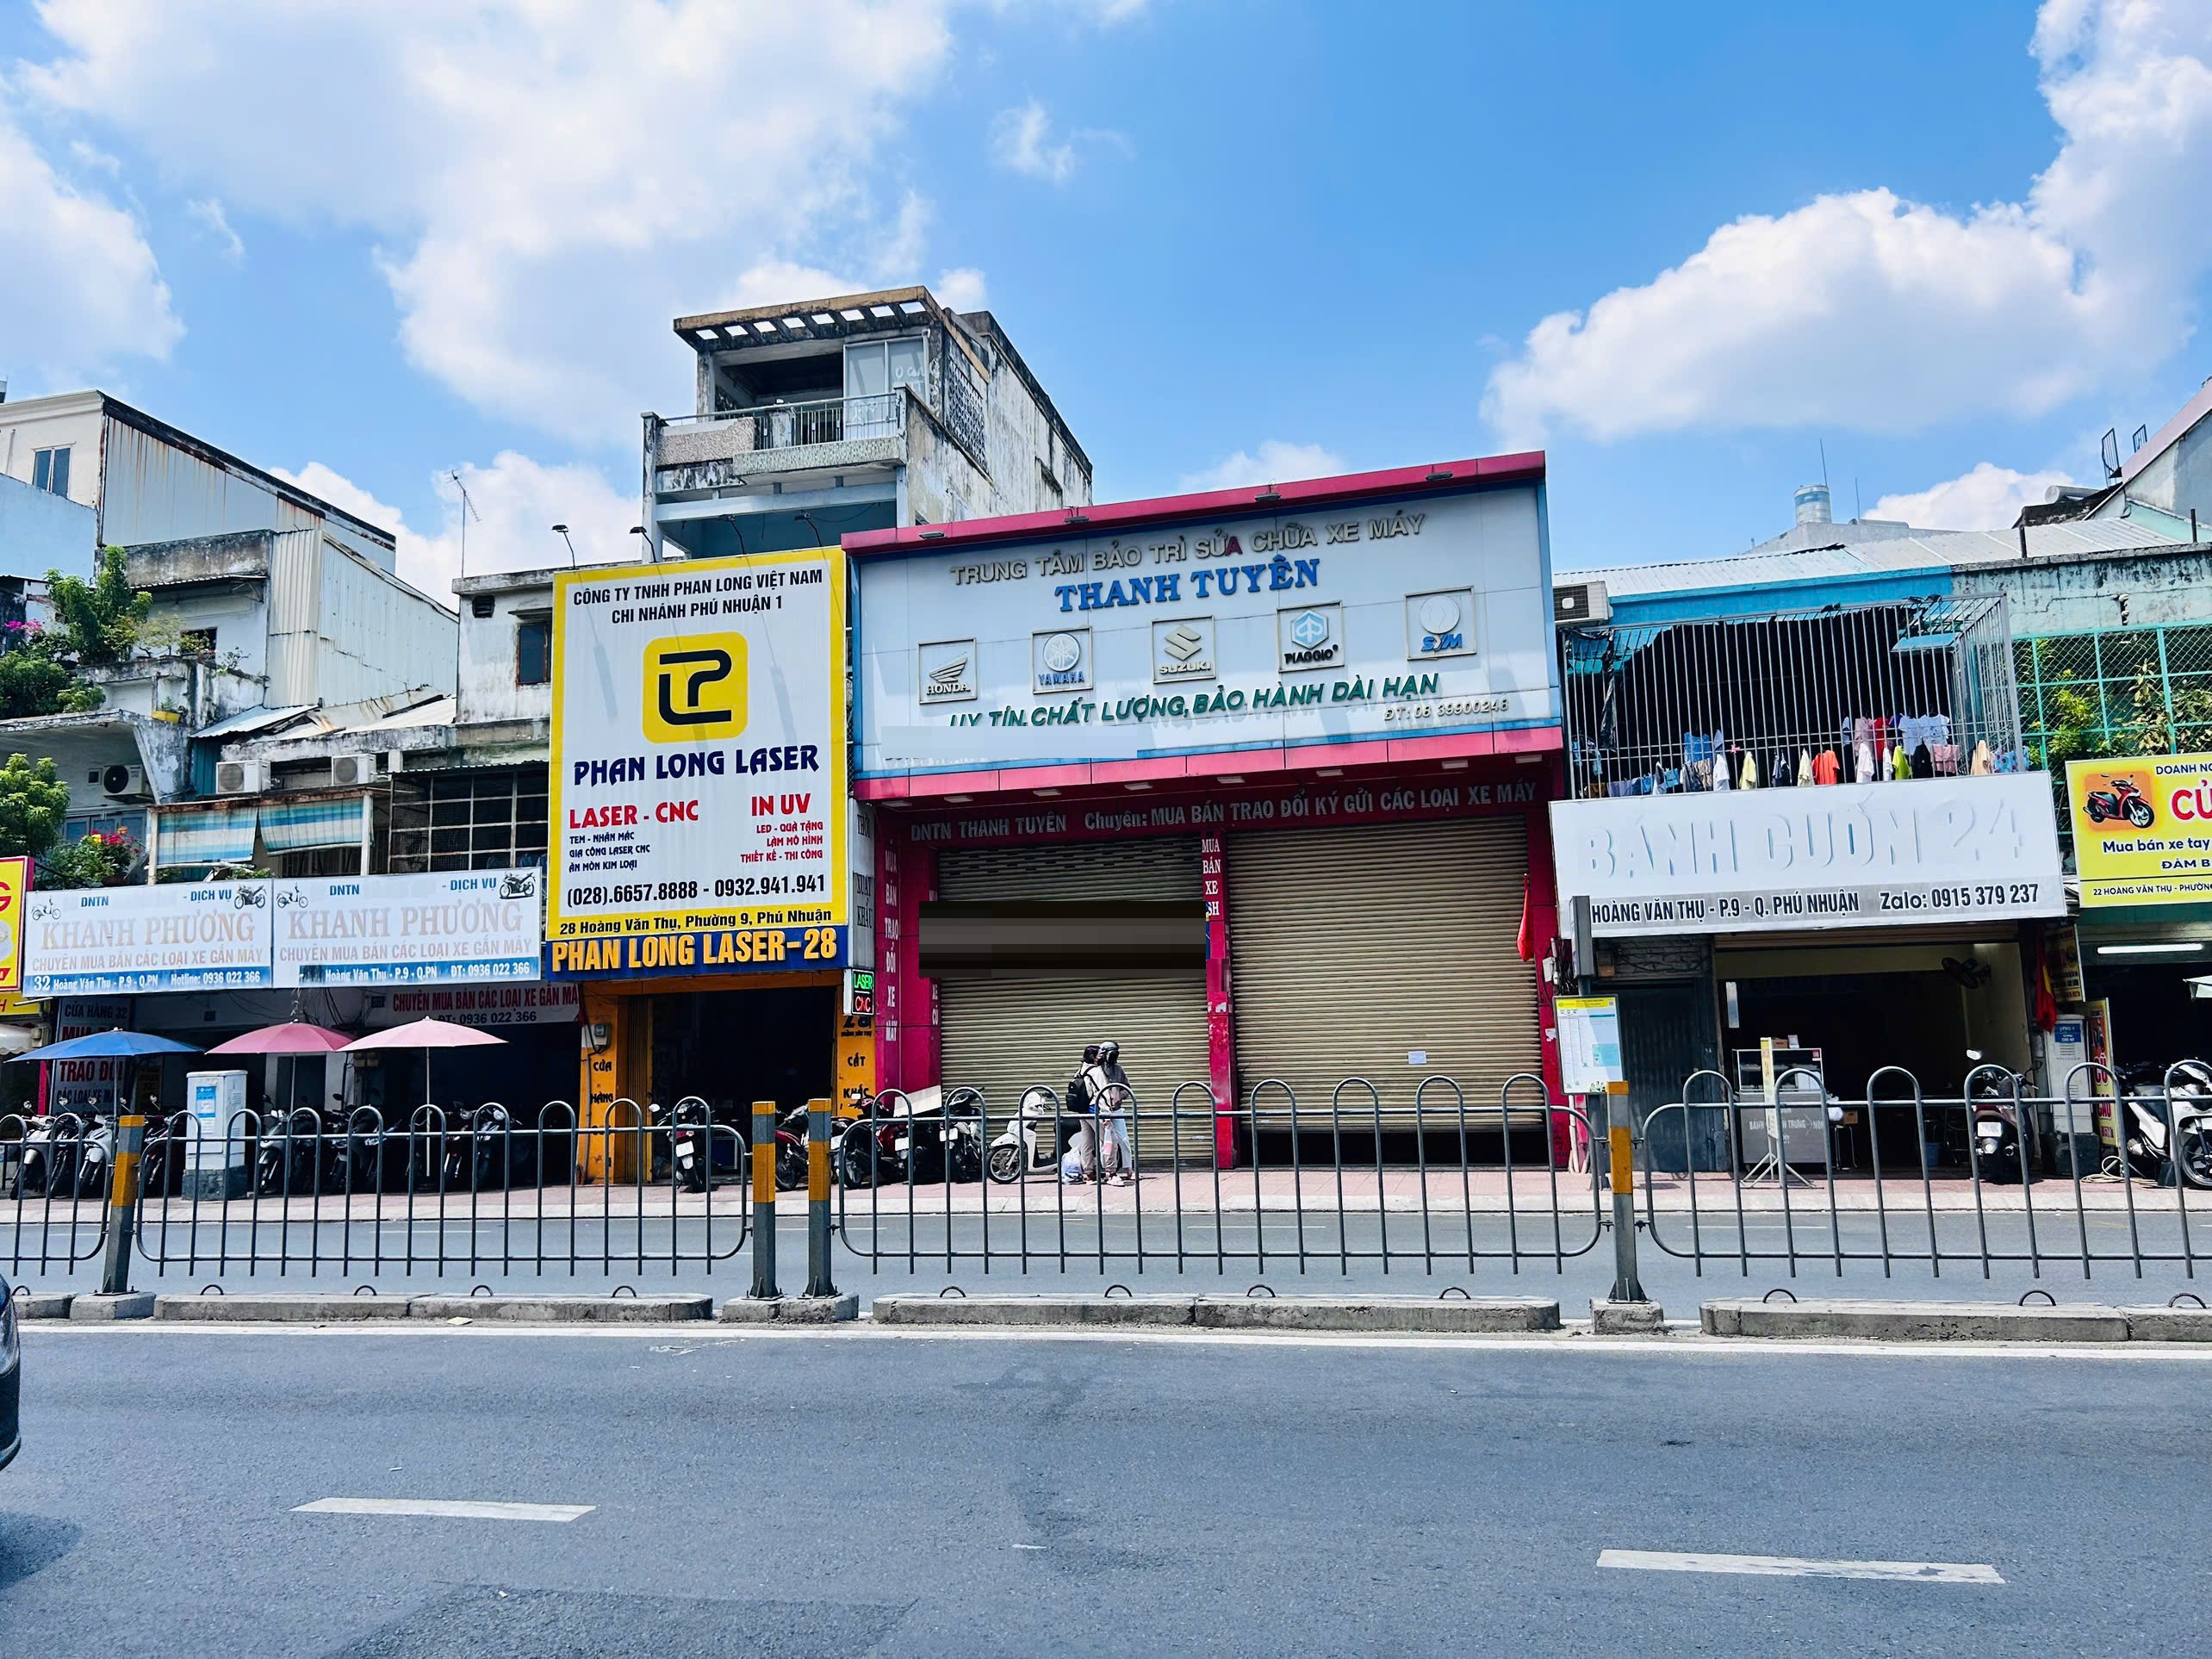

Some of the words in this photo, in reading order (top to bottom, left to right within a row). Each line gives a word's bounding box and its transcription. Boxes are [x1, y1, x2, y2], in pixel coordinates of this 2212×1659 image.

[951, 560, 1027, 585] TRUNG
[1035, 550, 1084, 575] TÂM
[1092, 540, 1141, 570] BẢO
[1150, 539, 1186, 563] TRÌ
[1195, 529, 1242, 559] SỬA
[1249, 523, 1317, 553] CHỮA
[1327, 522, 1359, 544] XE
[1369, 511, 1426, 540] MÁY
[574, 587, 611, 605] CÔNG
[615, 587, 630, 601] TY
[634, 583, 669, 600] TNHH
[674, 581, 711, 596] PHAN
[717, 575, 752, 593] LONG
[756, 570, 786, 588] VIỆT
[790, 569, 823, 586] NAM
[1055, 574, 1180, 612] THANH
[1190, 554, 1320, 598] TUYÊN
[612, 609, 634, 624] CHI
[638, 602, 687, 621] NHÁNH
[691, 598, 718, 617] PHÚ
[723, 596, 771, 614] NHUẬN
[775, 595, 782, 610] 1
[1421, 633, 1462, 652] SYM
[1284, 649, 1333, 664] PIAGGIO
[1159, 661, 1212, 674] SUZUKI
[1038, 671, 1084, 686] YAMAHA
[926, 682, 971, 696] HONDA
[950, 713, 982, 727] UY
[1031, 698, 1096, 726] CHẤT
[1193, 685, 1245, 714] BẢO
[1252, 681, 1323, 709] HÀNH
[1331, 674, 1374, 702] DÀI
[1382, 673, 1439, 701] HẠN
[574, 756, 645, 787] PHAN
[656, 750, 724, 780] LONG
[736, 744, 819, 776] LASER
[2156, 764, 2196, 774] DOANH
[751, 795, 774, 817] IN
[780, 793, 811, 814] UV
[910, 822, 952, 842] DNTN
[958, 818, 1010, 838] THANH
[1015, 811, 1067, 835] TUYÊN
[1084, 809, 1147, 831] Chuyên:
[1151, 807, 1185, 825] MUA
[1191, 799, 1225, 823] BÁN
[1230, 799, 1274, 821] TRAO
[1315, 790, 1339, 815] KÝ
[1380, 786, 1415, 811] CÁC
[1420, 787, 1459, 811] LOẠI
[1467, 785, 1492, 805] XE
[1497, 778, 1538, 803] MÁY
[569, 805, 637, 830] LASER
[656, 800, 699, 823] CNC
[756, 824, 772, 834] LED
[780, 821, 798, 833] QUÀ
[569, 836, 586, 845] TEM
[618, 830, 635, 842] MÁC
[767, 836, 784, 848] LÀM
[786, 835, 799, 846] MÔ
[802, 834, 823, 845] HÌNH
[2103, 841, 2134, 853] Mua
[2137, 839, 2164, 850] bán
[2169, 840, 2184, 849] xe
[2188, 838, 2209, 851] tay
[569, 848, 583, 859] GIA
[586, 846, 606, 857] CÔNG
[609, 846, 633, 856] LASER
[1202, 839, 1220, 853] MUA
[785, 851, 798, 861] THI
[800, 848, 823, 861] CÔNG
[582, 861, 600, 873] MÒN
[602, 861, 618, 871] KIM
[619, 859, 637, 872] LOẠI
[1202, 857, 1221, 873] BÁN
[2161, 858, 2196, 869] ĐẢM
[330, 884, 359, 896] DNTN
[450, 879, 477, 893] DỊCH
[482, 877, 497, 890] VỤ
[568, 881, 698, 908] (028).6657.8888
[714, 874, 824, 898] 0932.941.941
[1205, 881, 1218, 894] XE
[2104, 885, 2134, 895] HOÀNG
[2137, 885, 2153, 893] VĂN
[2156, 885, 2172, 894] THỤ
[81, 896, 109, 908] DNTN
[190, 890, 214, 904] DỊCH
[218, 888, 232, 903] VỤ
[1880, 892, 1928, 910] Zalo:
[1931, 887, 1970, 907] 0915
[1975, 885, 2005, 905] 379
[2010, 883, 2038, 904] 237
[1592, 898, 1639, 923] HOÀNG
[1644, 897, 1675, 921] VĂN
[1679, 900, 1705, 923] THỤ
[1719, 898, 1740, 917] P.9
[1773, 891, 1803, 915] PHÚ
[1806, 889, 1860, 915] NHUẬN
[288, 907, 391, 940] KHANH
[401, 898, 523, 936] PHƯƠNG
[560, 923, 576, 935] 28
[580, 919, 621, 935] Hoàng
[624, 916, 649, 931] Văn
[653, 916, 681, 932] Thụ,
[685, 913, 736, 928] Phường
[741, 912, 753, 926] 9,
[757, 911, 782, 923] Phú
[787, 909, 831, 923] Nhuận
[40, 918, 140, 950] KHANH
[145, 908, 255, 947] PHƯƠNG
[885, 917, 898, 941] TRAO
[279, 942, 327, 961] CHUYÊN
[332, 947, 358, 961] MUA
[363, 941, 388, 960] BÁN
[392, 939, 416, 959] CÁC
[420, 942, 449, 960] LOẠI
[453, 941, 469, 957] XE
[551, 939, 621, 972] PHAN
[628, 935, 696, 967] LONG
[32, 952, 77, 972] CHUYÊN
[80, 954, 105, 969] MUA
[109, 949, 132, 968] BÁN
[136, 948, 158, 966] CÁC
[161, 951, 187, 968] LOẠI
[192, 949, 207, 964] XE
[468, 964, 490, 976] 0936
[493, 963, 510, 975] 022
[513, 962, 530, 974] 366
[34, 976, 51, 991] 32
[202, 972, 224, 984] 0936
[226, 971, 242, 983] 022
[244, 971, 260, 983] 366
[854, 973, 872, 990] LASER
[393, 990, 430, 1012] CHUYÊN
[432, 994, 452, 1010] MUA
[456, 987, 475, 1010] BÁN
[478, 985, 497, 1009] CÁC
[500, 990, 521, 1012] LOẠI
[524, 989, 537, 1007] XE
[855, 996, 871, 1012] CNC
[887, 985, 896, 1007] XE
[460, 1014, 487, 1028] 0936
[491, 1012, 512, 1027] 022
[516, 1011, 537, 1026] 366
[59, 1061, 95, 1082] TRAO
